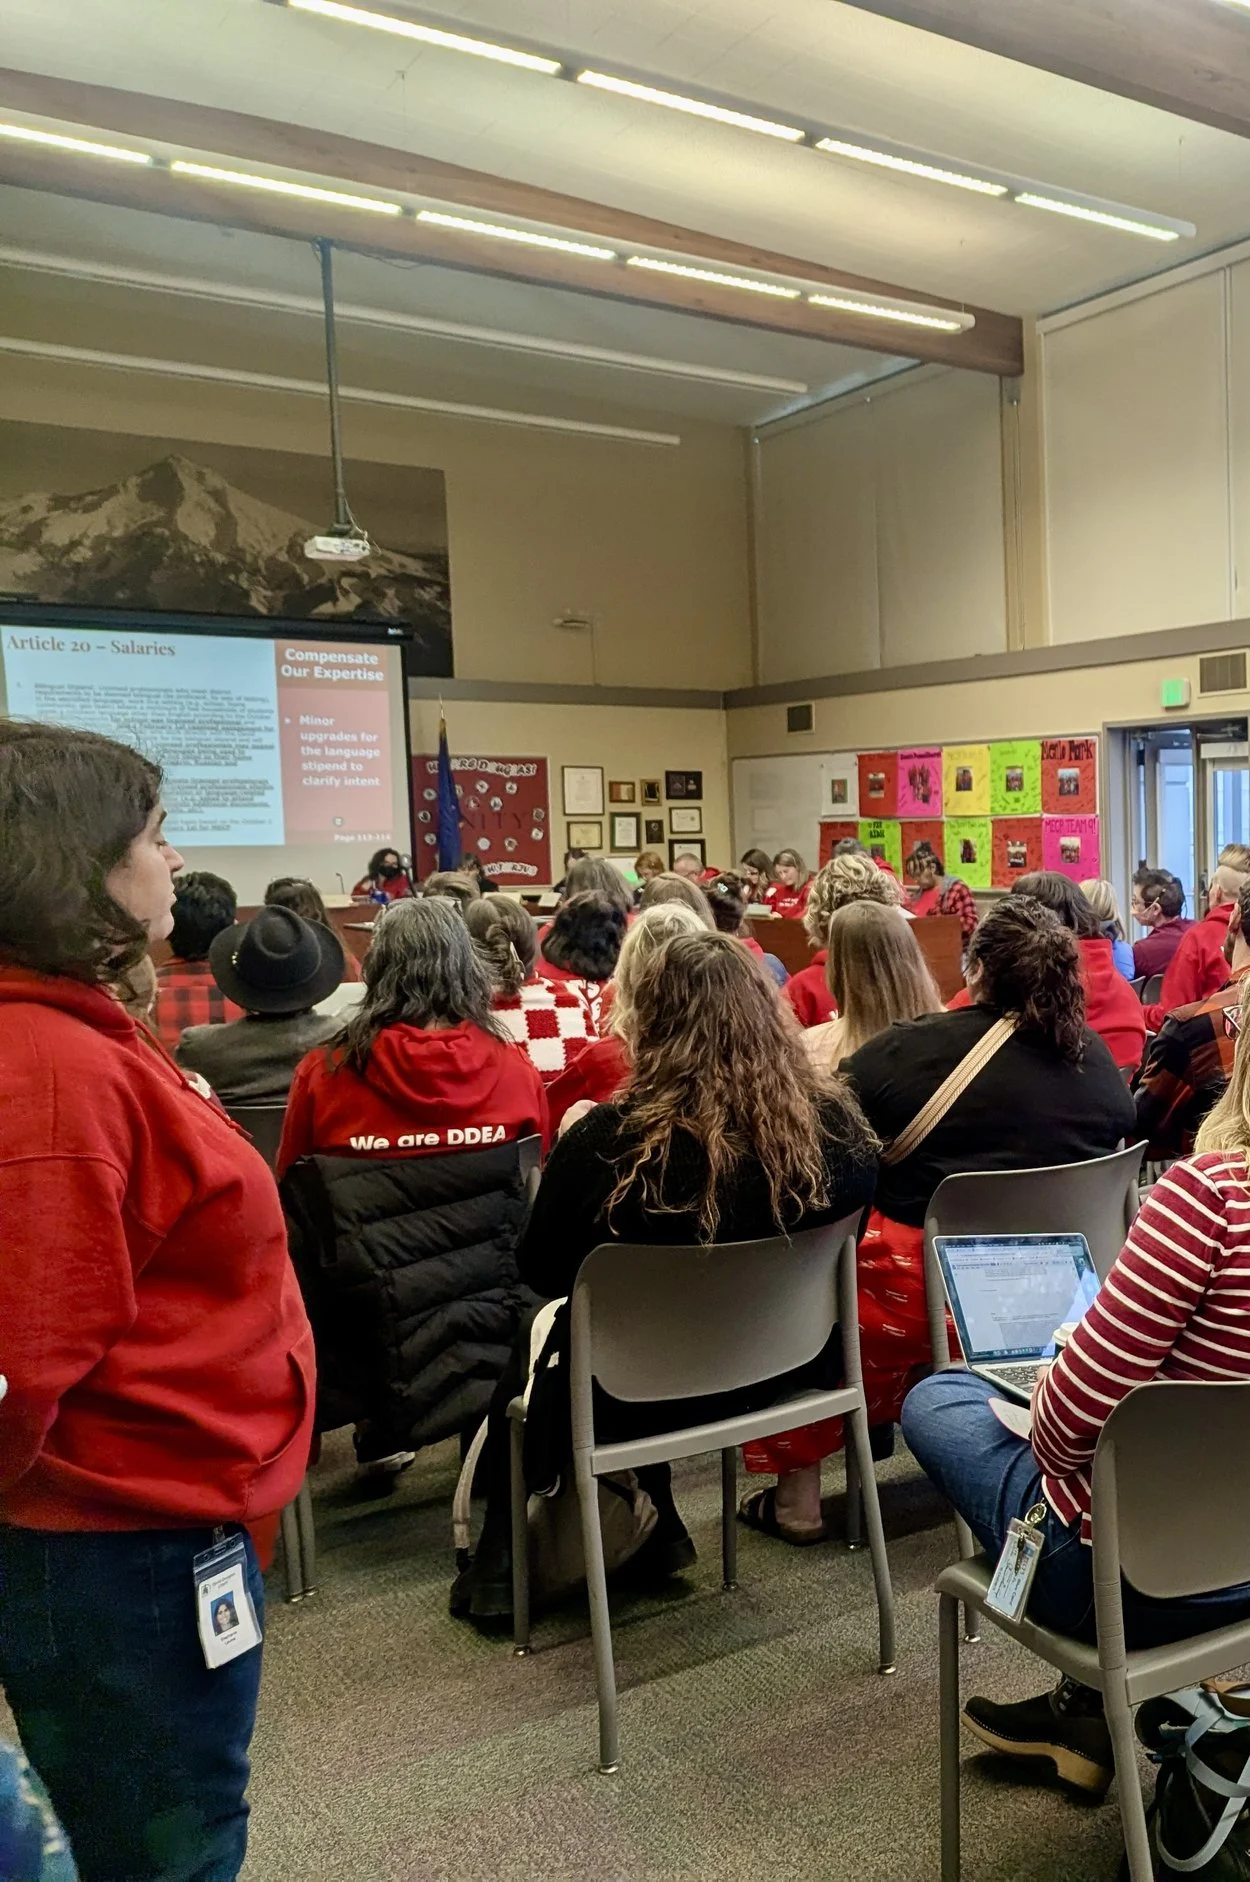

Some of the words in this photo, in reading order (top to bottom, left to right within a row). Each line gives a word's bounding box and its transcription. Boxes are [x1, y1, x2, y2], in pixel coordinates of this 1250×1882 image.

[8, 635, 65, 652] Article
[71, 641, 91, 653] 20
[111, 639, 176, 656] Salaries
[284, 648, 379, 665] Compensate
[281, 665, 309, 678] Our
[314, 665, 384, 682] Expertise
[299, 715, 335, 726] Minor
[300, 731, 357, 745] upgrades
[360, 731, 378, 743] for
[301, 746, 321, 756] the
[324, 746, 381, 760] language
[302, 760, 347, 773] stipend
[350, 761, 364, 771] to
[302, 775, 341, 788] clarify
[344, 775, 380, 786] intent
[1066, 818, 1087, 834] TEAM
[334, 833, 355, 843] Page
[350, 1135, 390, 1150] We
[398, 1132, 440, 1148] are
[447, 1125, 506, 1145] DDEA
